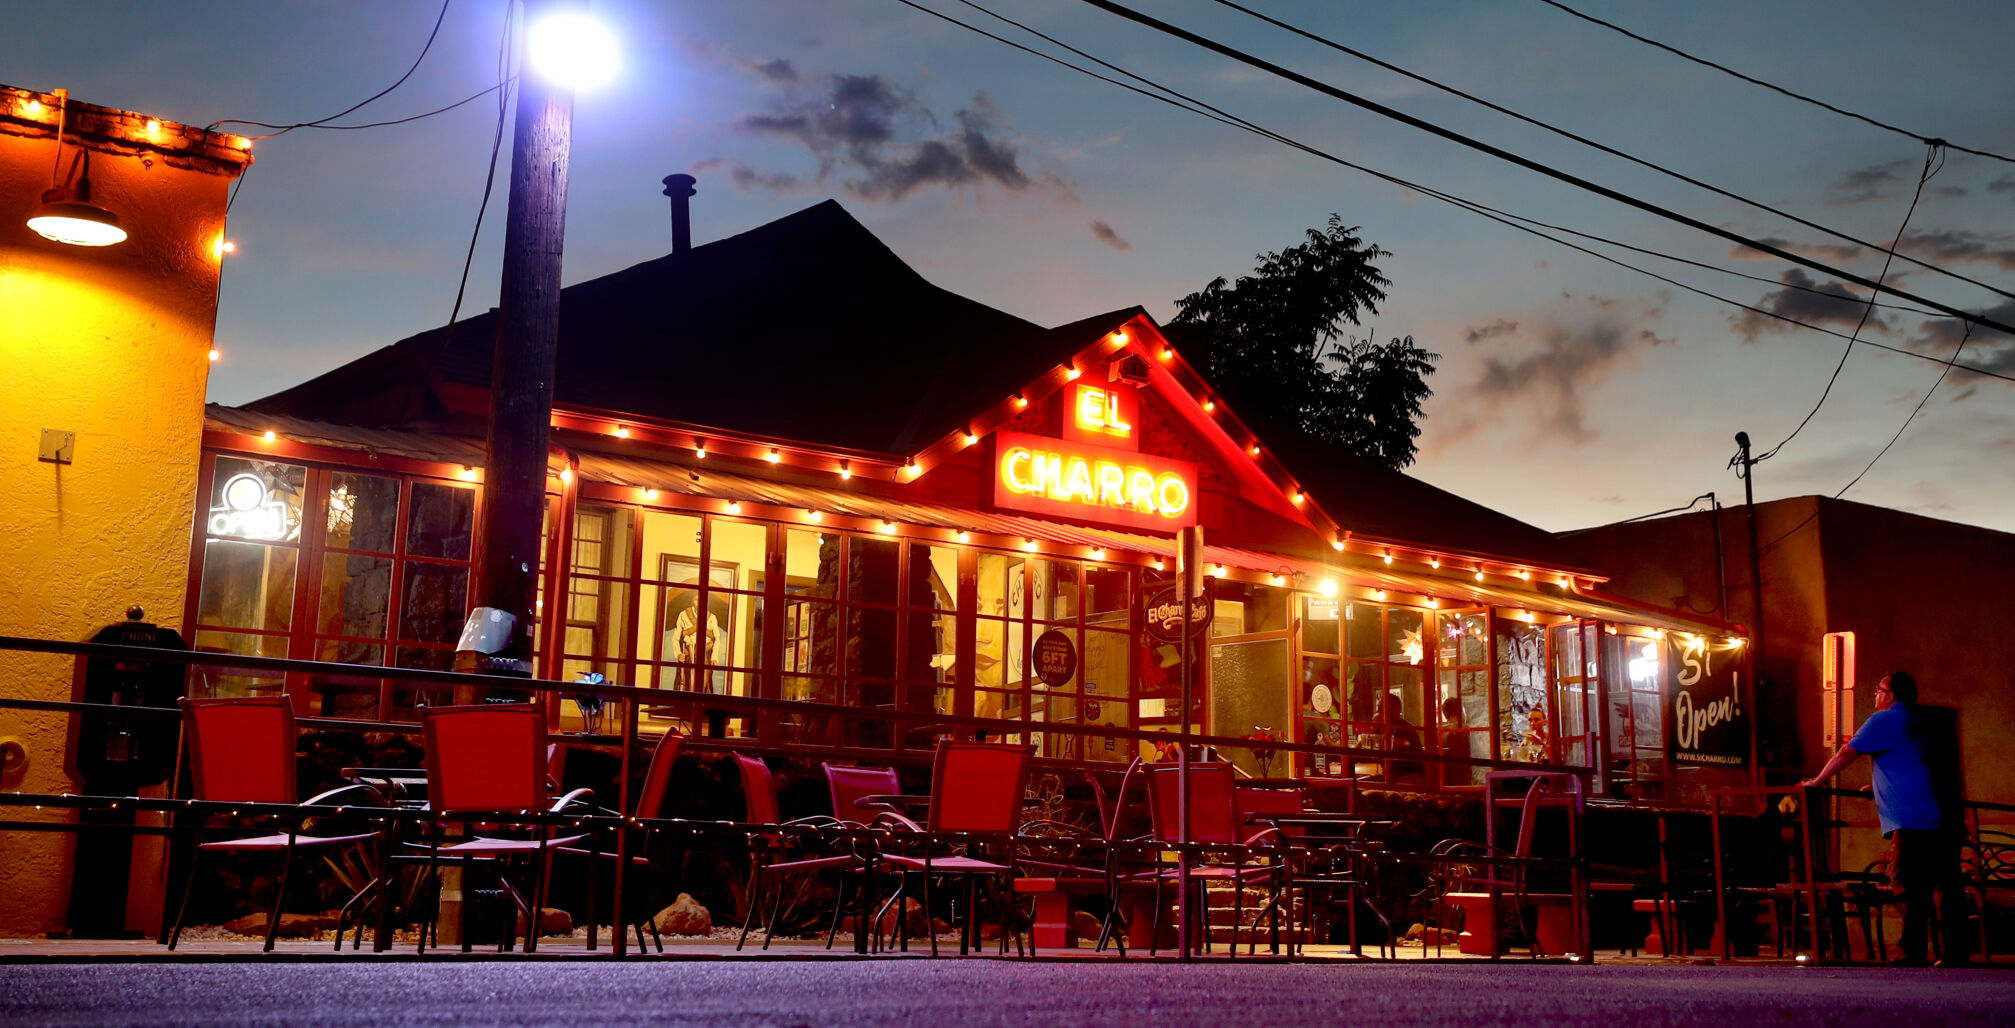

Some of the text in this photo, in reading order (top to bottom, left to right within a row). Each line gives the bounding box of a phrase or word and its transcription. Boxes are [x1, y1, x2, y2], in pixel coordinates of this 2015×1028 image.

[1076, 384, 1131, 438] EL
[1001, 446, 1189, 519] CHARRO
[121, 631, 159, 642] PHONE
[1042, 651, 1067, 665] 6FT
[1042, 664, 1067, 674] APART
[1676, 671, 1741, 750] Open!
